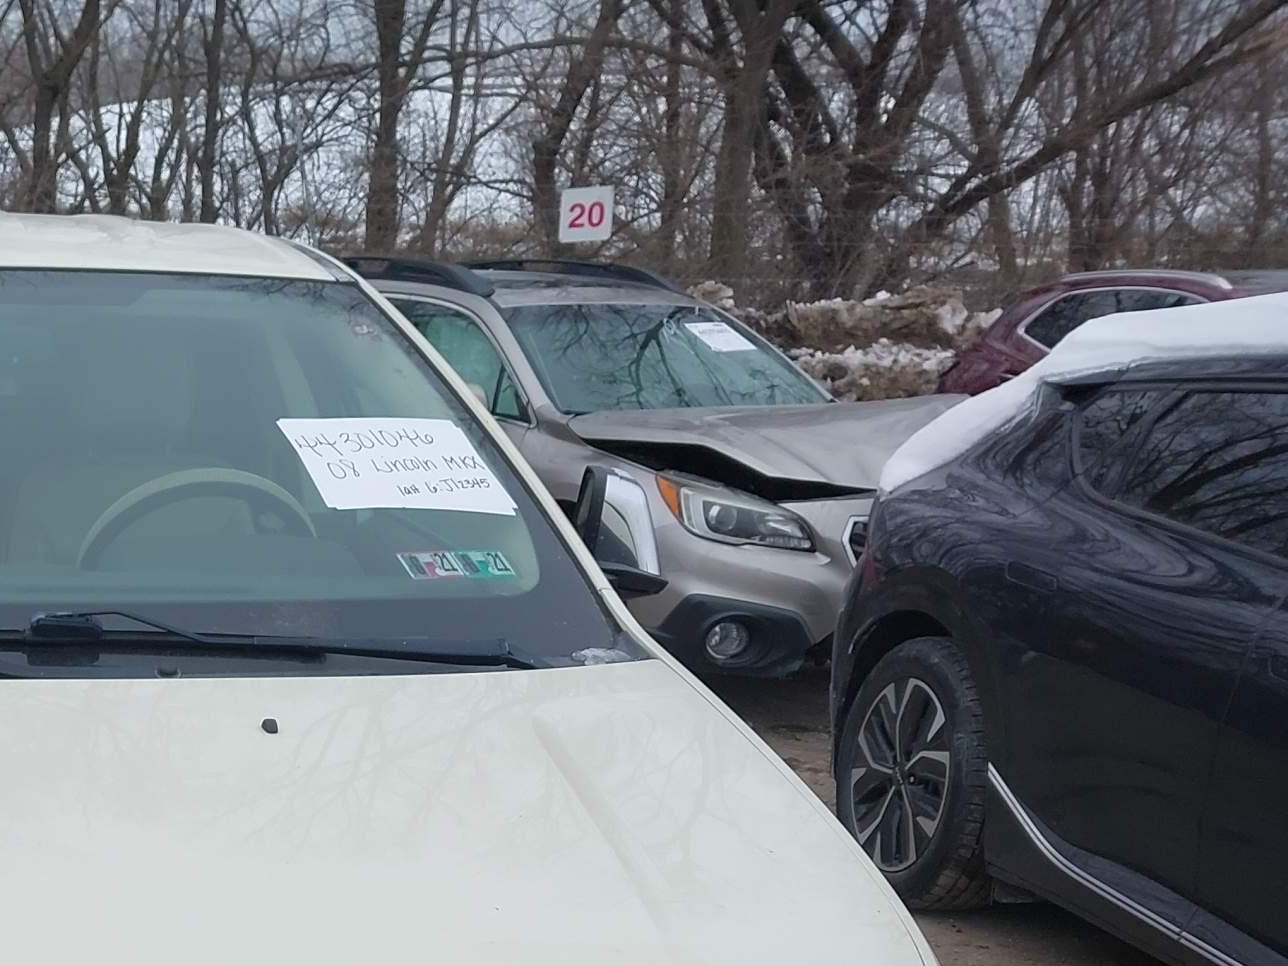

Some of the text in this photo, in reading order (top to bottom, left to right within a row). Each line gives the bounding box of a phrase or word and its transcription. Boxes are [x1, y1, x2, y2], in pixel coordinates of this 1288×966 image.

[568, 201, 605, 229] 20
[294, 427, 435, 457] 44301046
[326, 455, 486, 480] 08 Lincoln MKX
